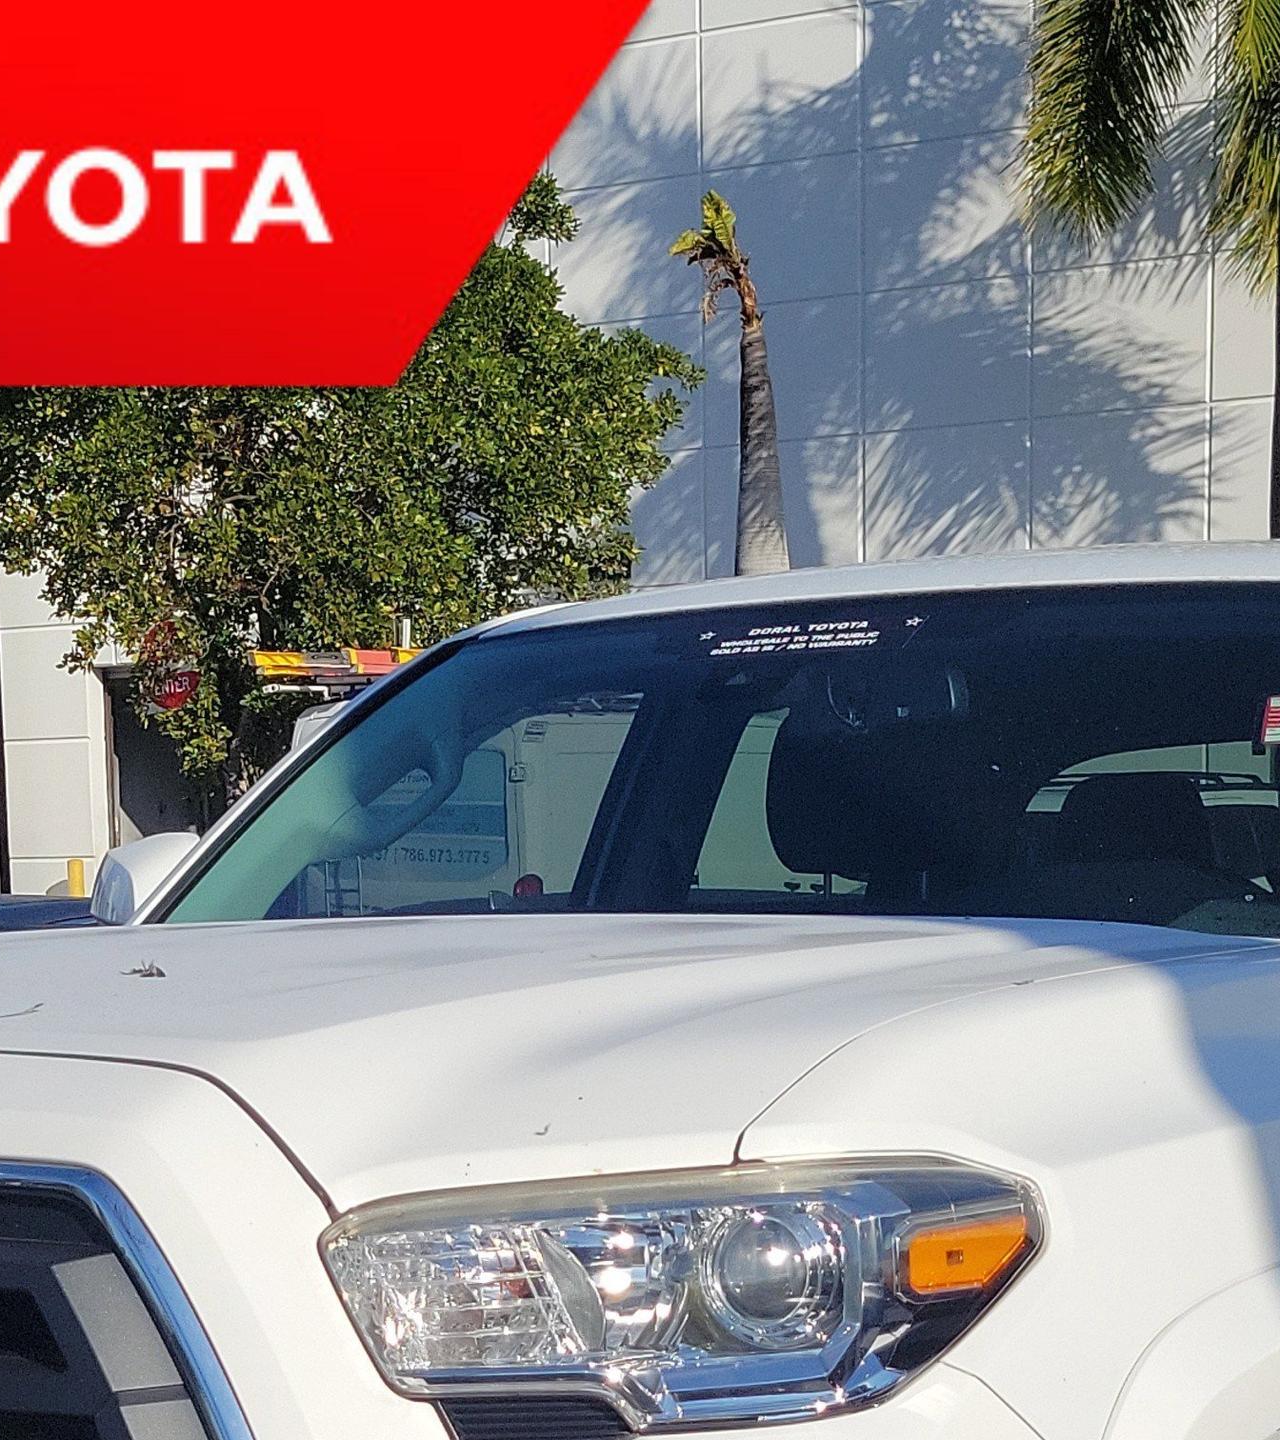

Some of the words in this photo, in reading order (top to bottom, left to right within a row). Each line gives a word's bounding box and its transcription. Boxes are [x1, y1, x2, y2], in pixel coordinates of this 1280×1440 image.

[748, 625, 801, 636] DORAL
[808, 620, 869, 632] TOYOTA
[710, 646, 741, 656] SOLD
[787, 642, 806, 650] NO
[808, 638, 877, 649] WARRANTY
[720, 636, 788, 648] WHOLESALE
[793, 635, 809, 643] TO
[812, 633, 834, 641] THE
[836, 631, 880, 640] PUBLIC
